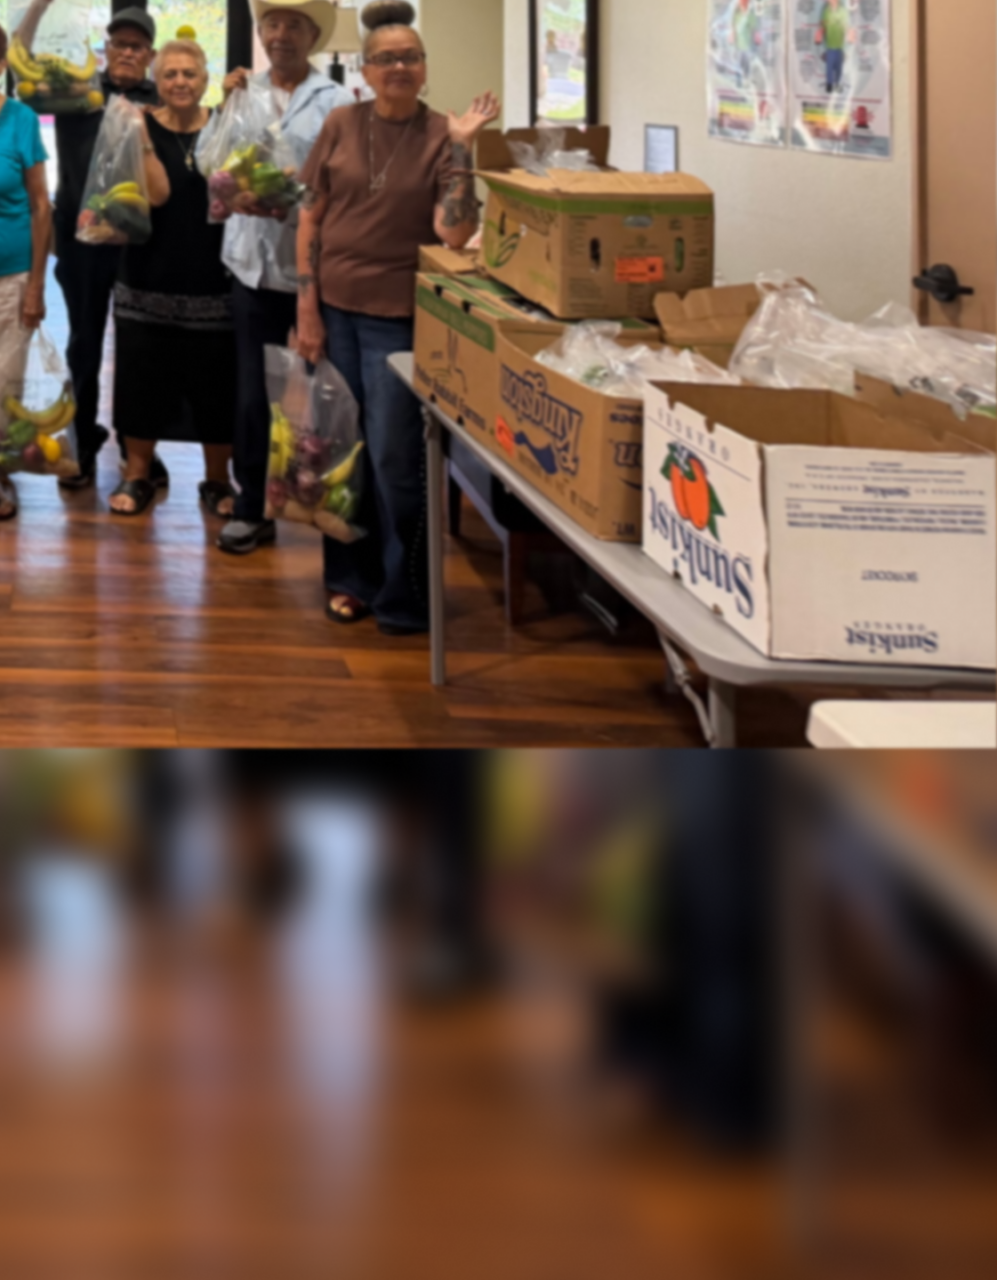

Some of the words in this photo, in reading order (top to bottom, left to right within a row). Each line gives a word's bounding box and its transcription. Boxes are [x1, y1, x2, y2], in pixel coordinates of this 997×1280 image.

[500, 363, 583, 477] Kingston
[648, 486, 755, 619] Sunkist
[844, 625, 939, 655] Sunkist
